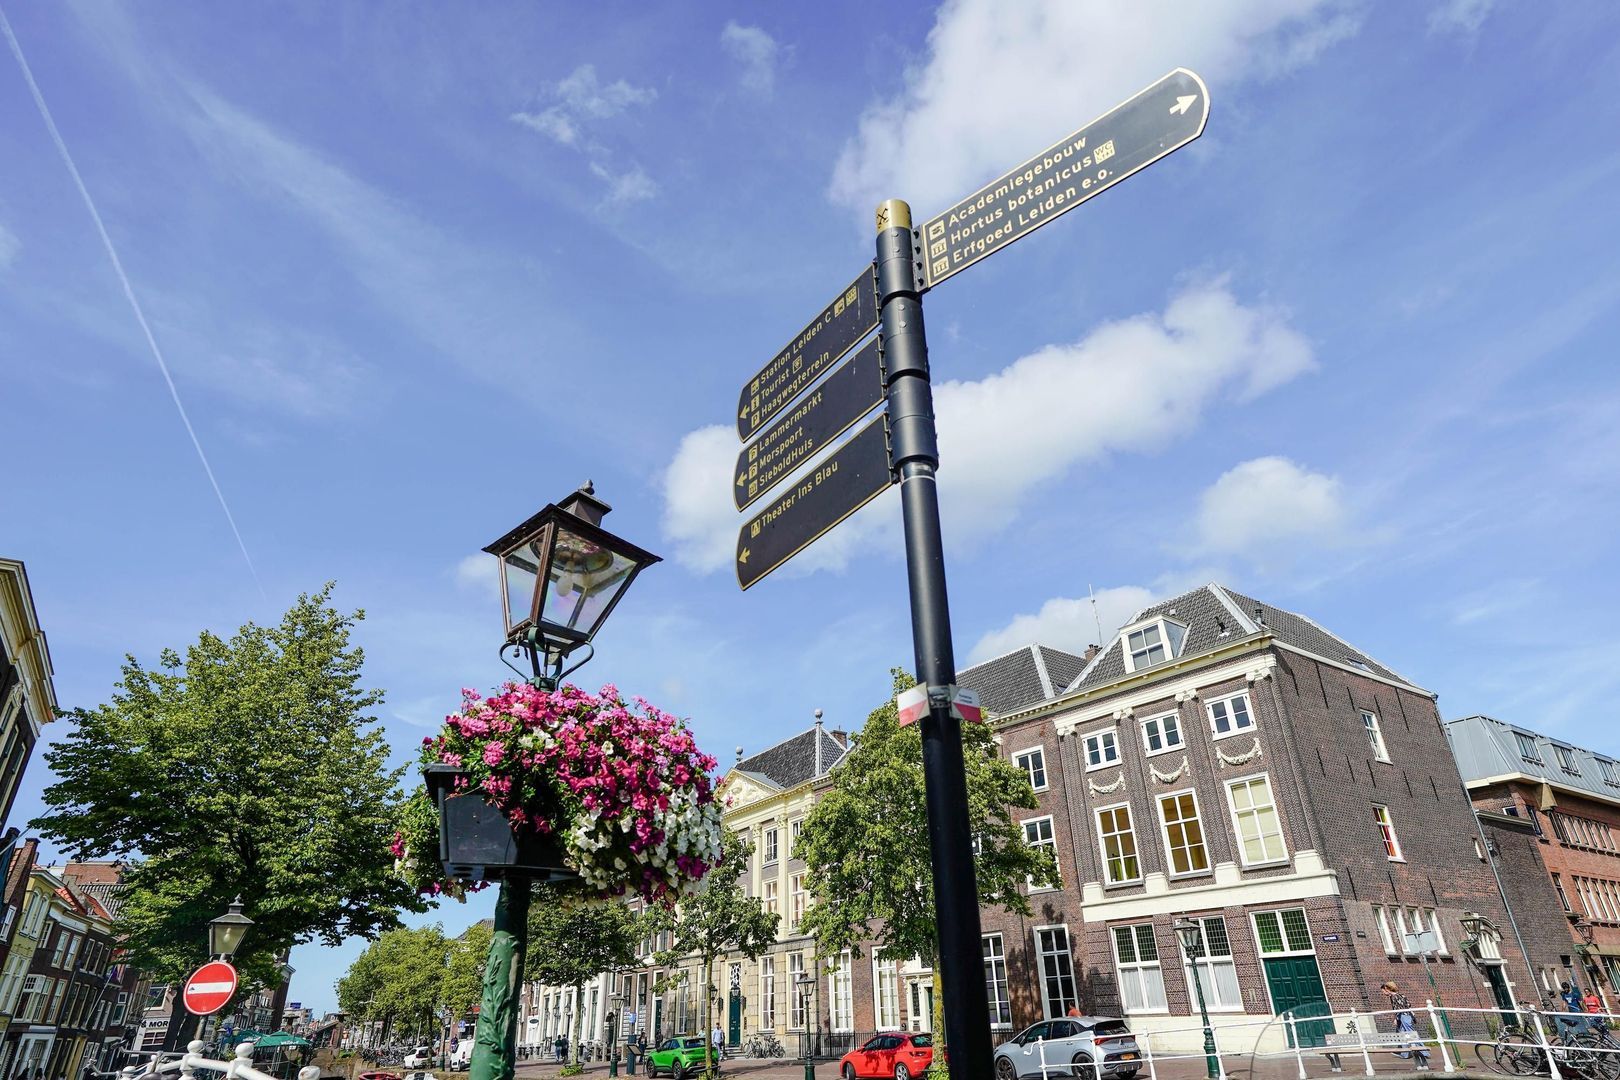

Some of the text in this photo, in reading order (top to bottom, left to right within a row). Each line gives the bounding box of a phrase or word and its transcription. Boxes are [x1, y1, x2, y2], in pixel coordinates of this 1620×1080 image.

[949, 137, 1087, 228] Academiegebouw
[950, 155, 1092, 245] Hortus botanicus
[953, 168, 1114, 264] Erfgoed Leiden e.o.
[760, 311, 832, 385] Station Leiden C
[760, 367, 789, 400] Tourist
[761, 351, 830, 418] Haagwegterrein
[759, 391, 822, 452] Lammermarkt
[759, 426, 803, 469] Morspoort
[759, 438, 813, 487] SieboldHuis
[761, 494, 796, 527] Theater
[815, 461, 838, 486] Blau
